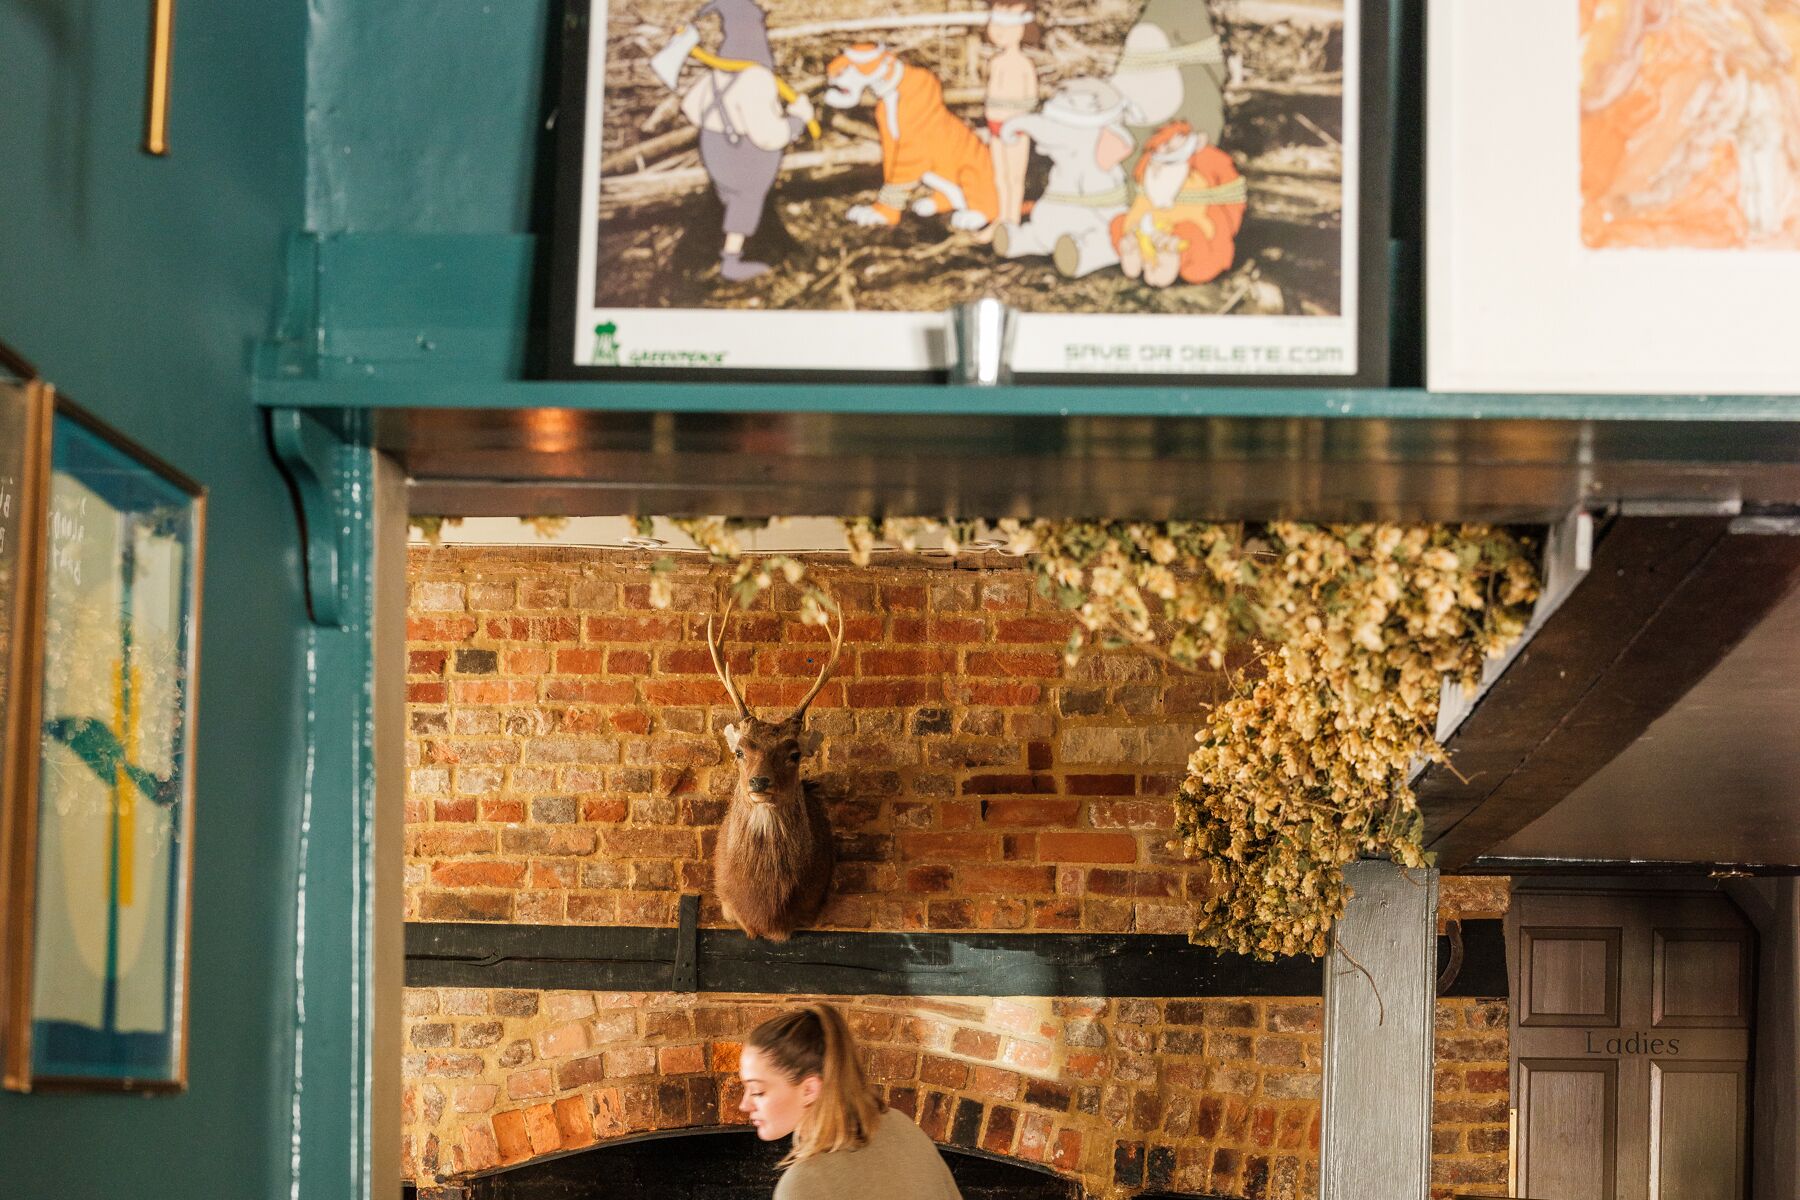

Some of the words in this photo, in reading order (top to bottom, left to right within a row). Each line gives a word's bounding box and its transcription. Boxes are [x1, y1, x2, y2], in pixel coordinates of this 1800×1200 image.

[1064, 344, 1131, 361] SAVE
[1139, 345, 1173, 361] OR
[1585, 1031, 1680, 1055] Ladies
